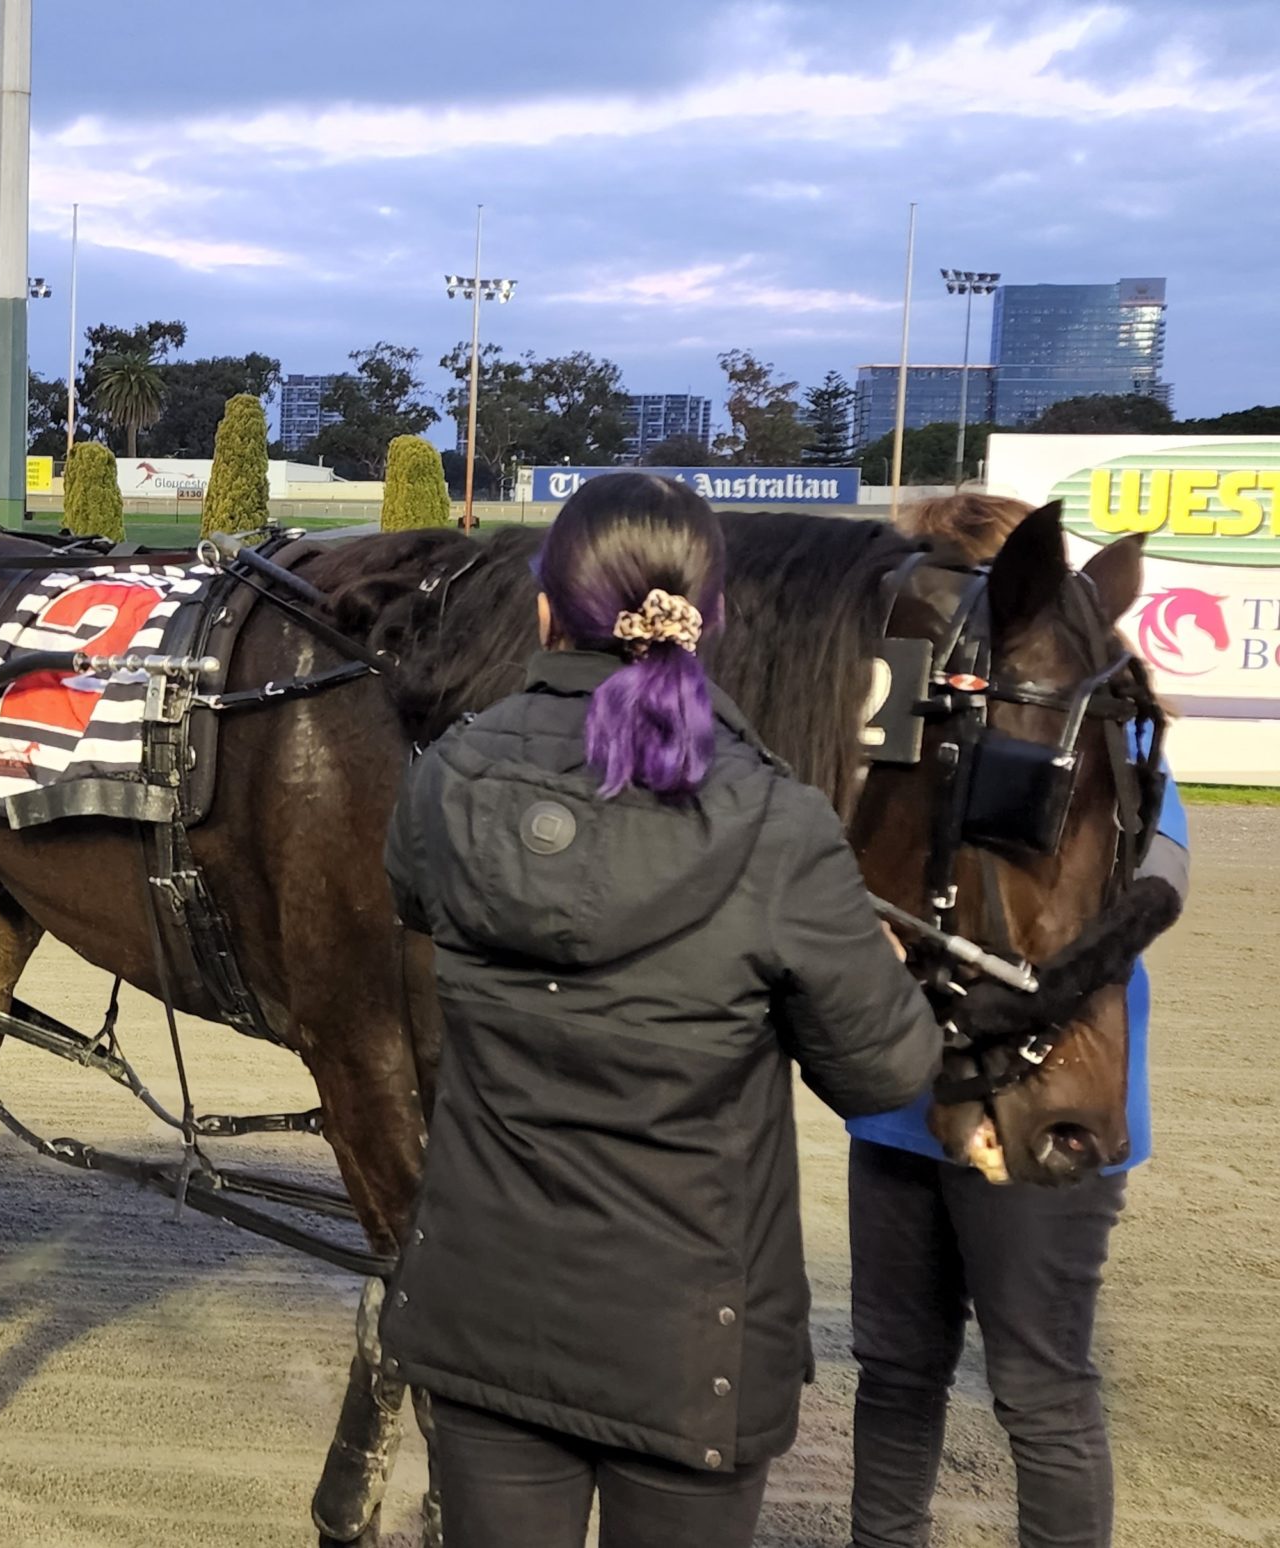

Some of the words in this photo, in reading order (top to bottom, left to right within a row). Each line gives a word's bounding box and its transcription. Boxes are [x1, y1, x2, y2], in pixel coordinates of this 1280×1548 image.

[179, 490, 202, 498] 2130
[693, 473, 840, 499] Australian
[1243, 598, 1280, 631] T
[1240, 638, 1280, 671] B
